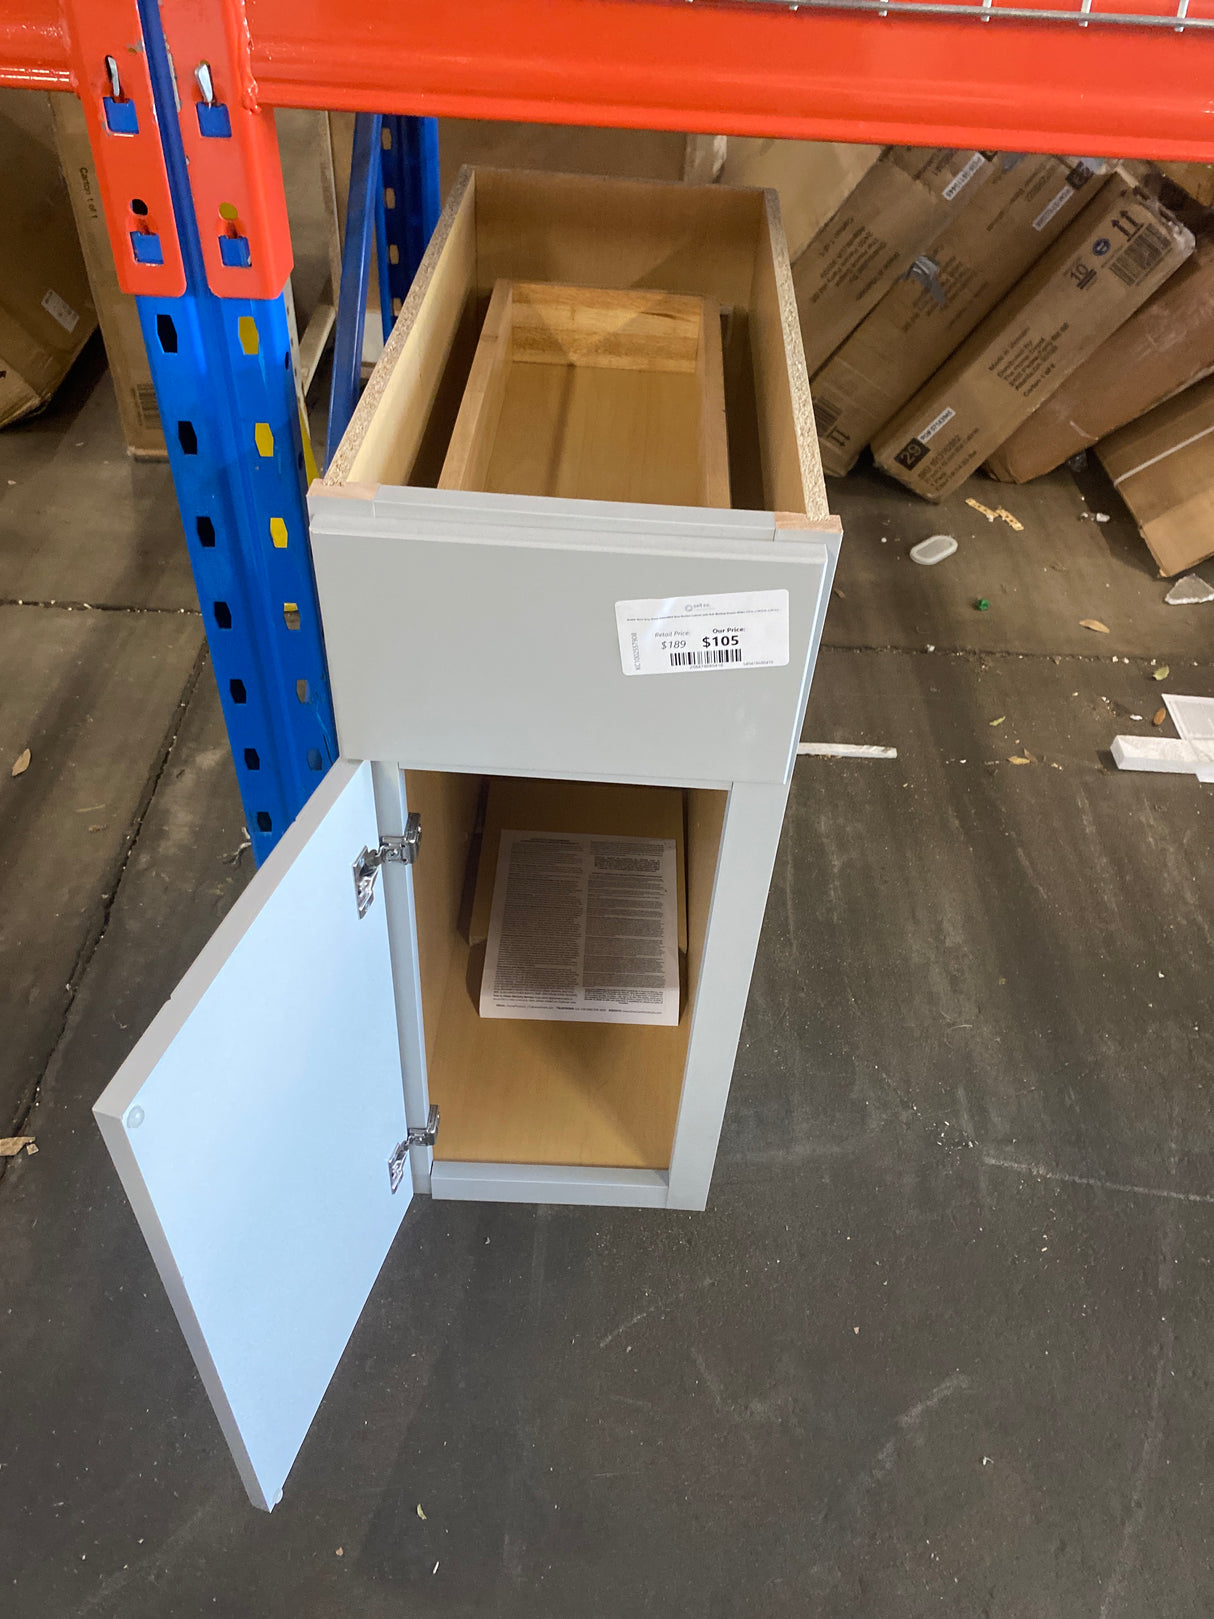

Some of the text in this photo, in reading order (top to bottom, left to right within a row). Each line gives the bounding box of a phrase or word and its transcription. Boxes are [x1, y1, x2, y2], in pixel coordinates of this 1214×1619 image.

[80, 167, 91, 195] Carton
[1070, 263, 1089, 281] 10
[900, 444, 922, 466] 29
[661, 640, 687, 650] $189
[702, 635, 739, 648] $105
